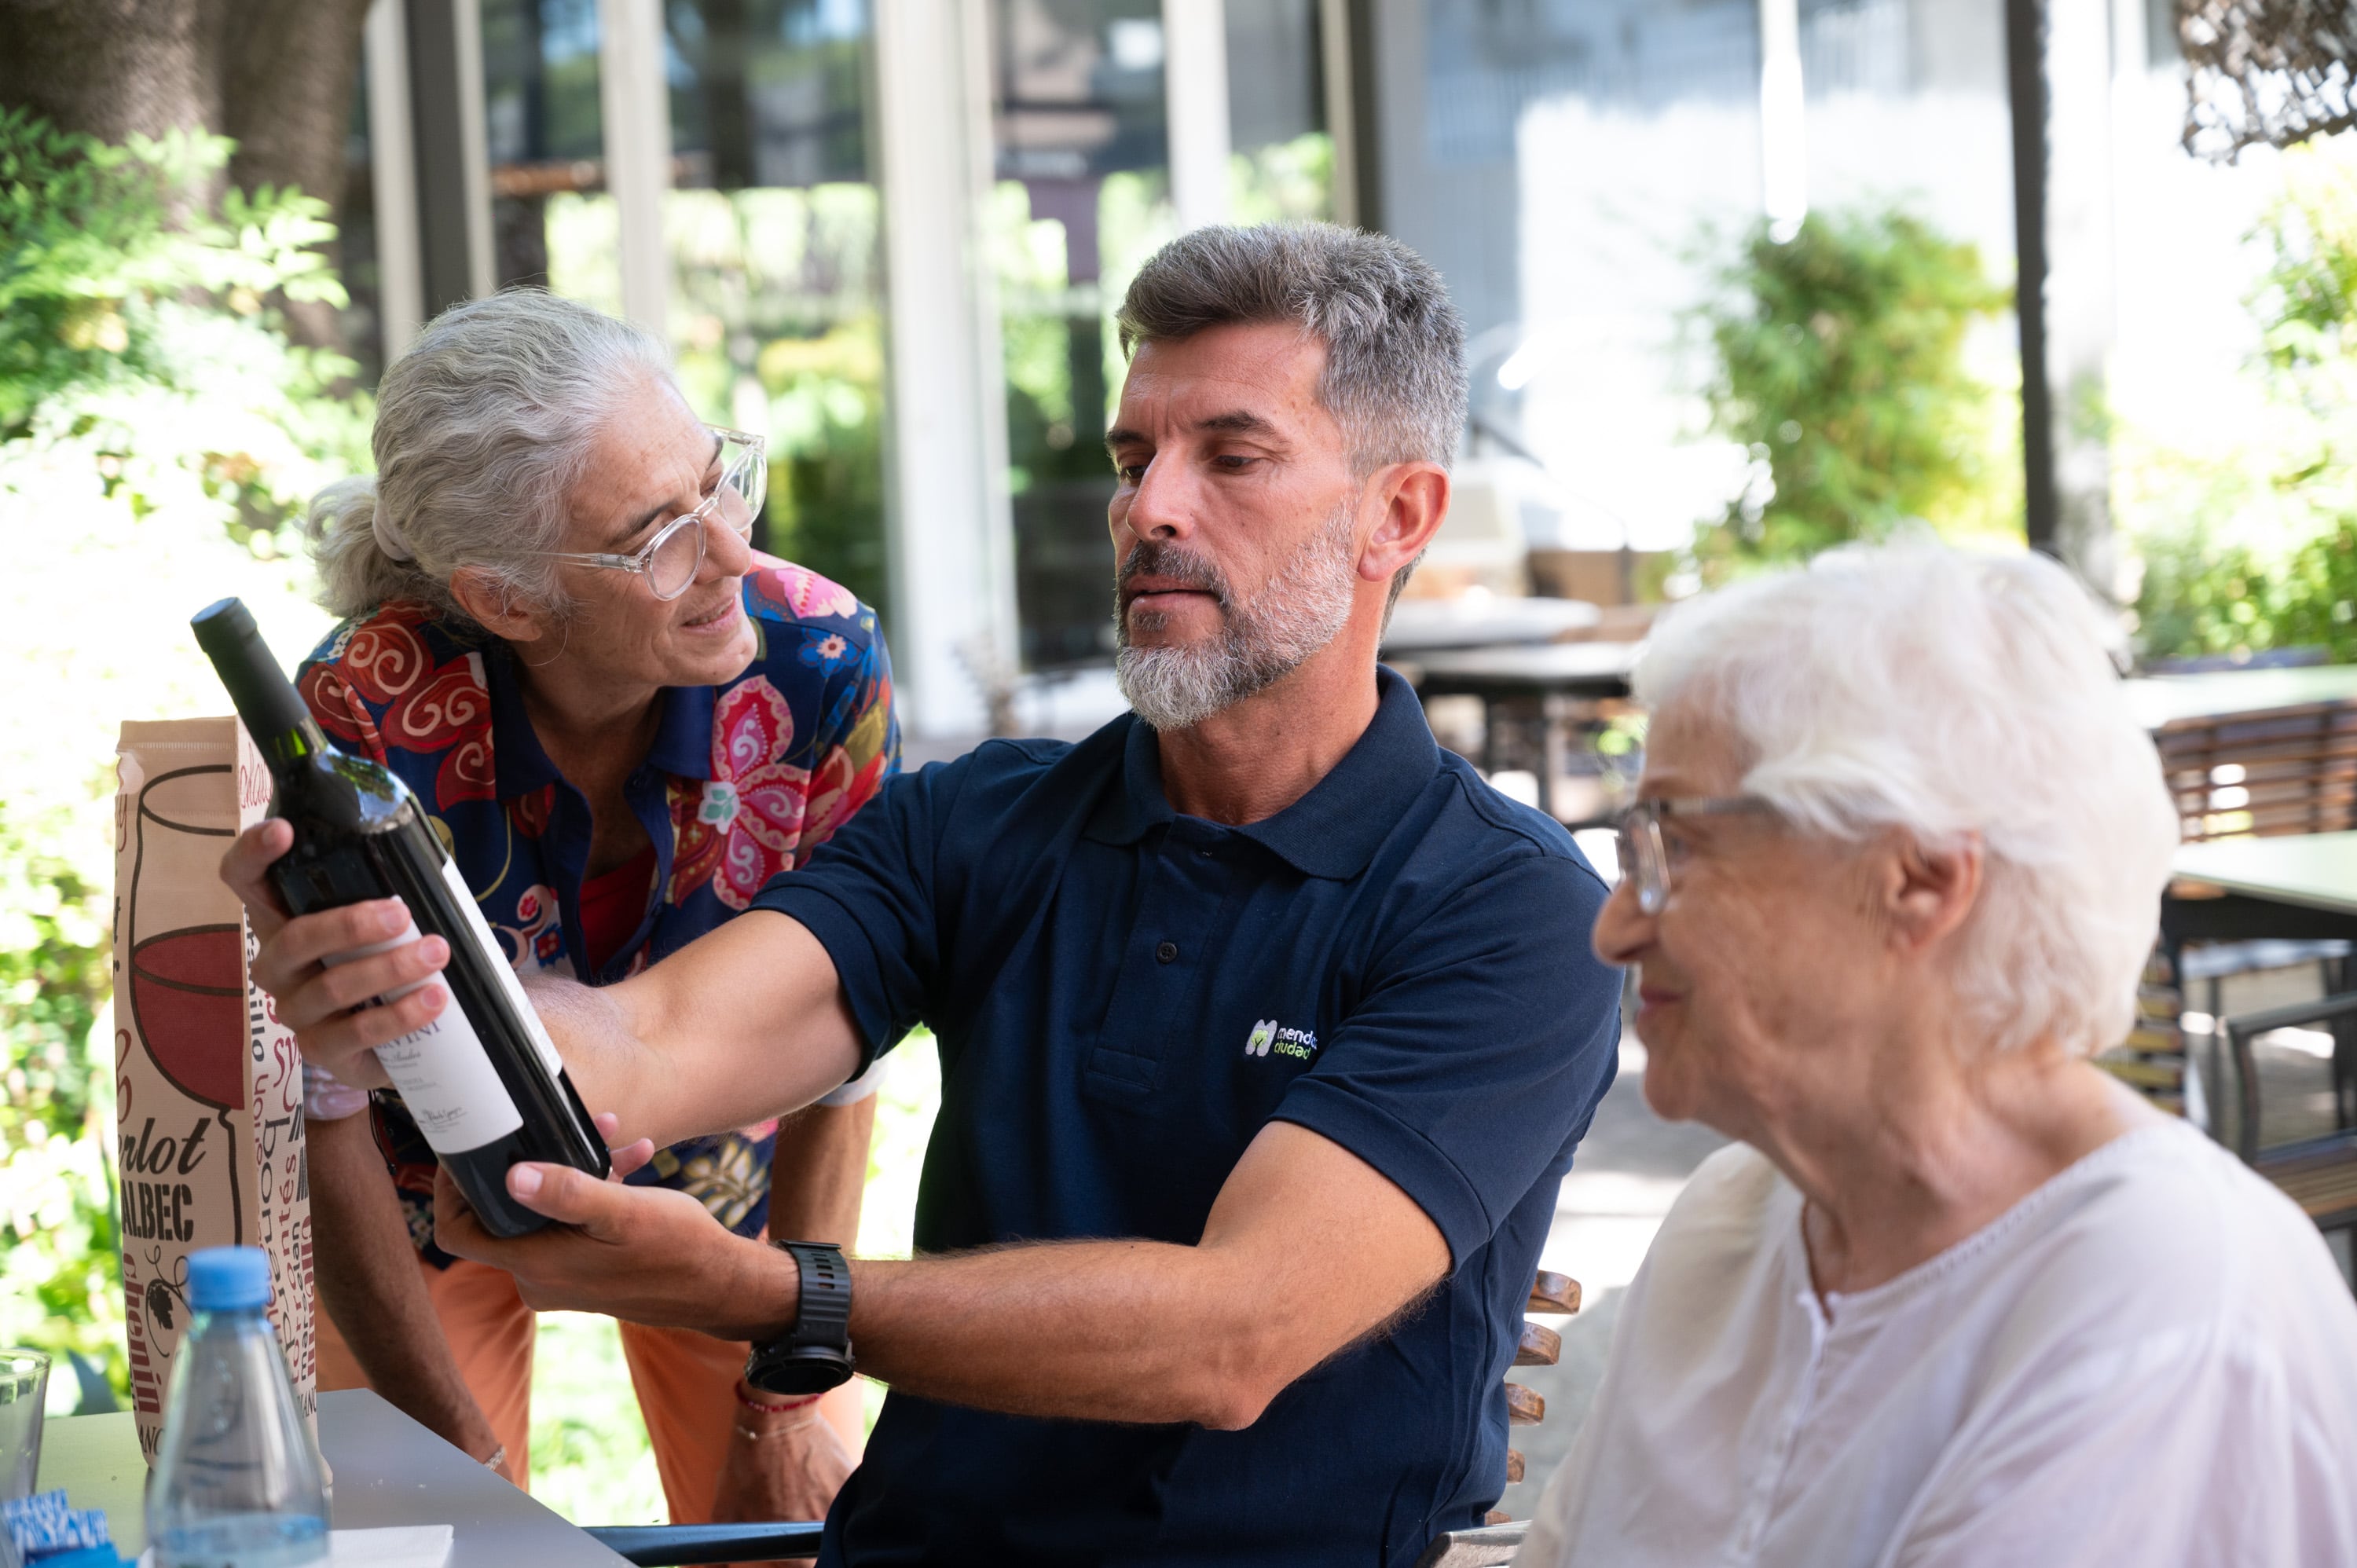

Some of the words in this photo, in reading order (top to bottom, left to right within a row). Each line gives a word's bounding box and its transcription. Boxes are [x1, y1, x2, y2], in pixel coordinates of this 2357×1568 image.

[121, 1179, 194, 1243] ALBEC
[123, 1252, 163, 1415] chenin
[139, 1423, 166, 1456] ANC
